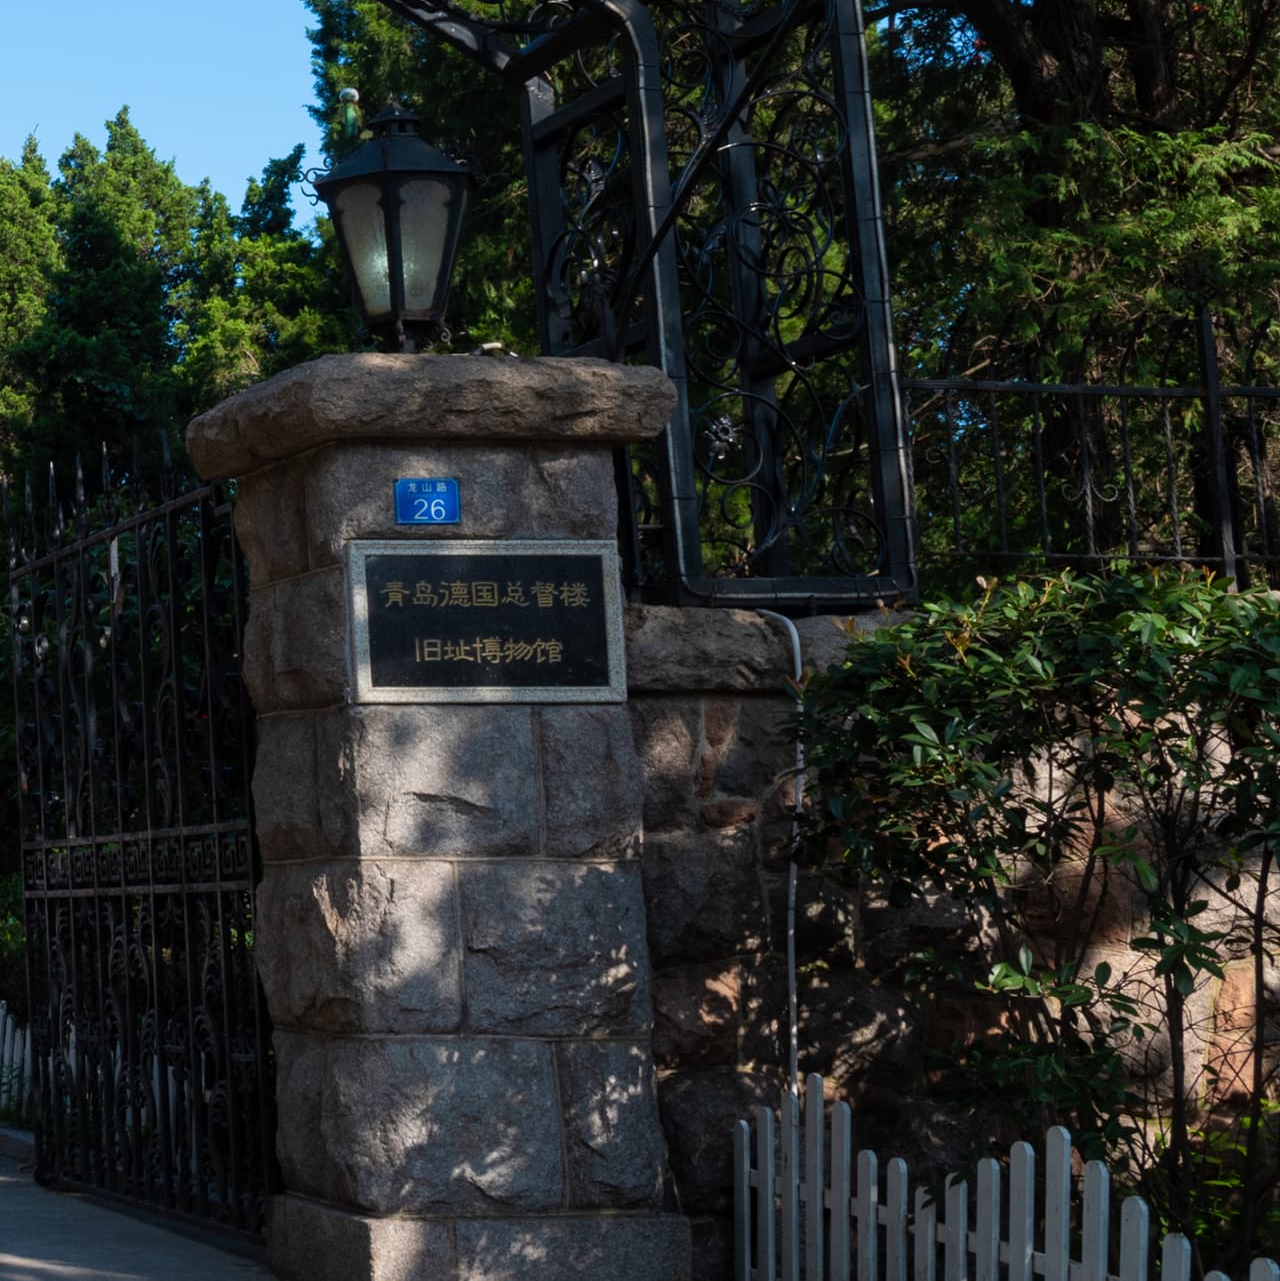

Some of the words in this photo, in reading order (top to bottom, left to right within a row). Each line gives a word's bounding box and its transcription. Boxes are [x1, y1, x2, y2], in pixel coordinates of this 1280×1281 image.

[407, 482, 447, 493] 龙山路
[414, 498, 446, 520] 26
[380, 580, 591, 608] 青岛德国总督楼
[414, 636, 564, 664] 旧址博物馆
